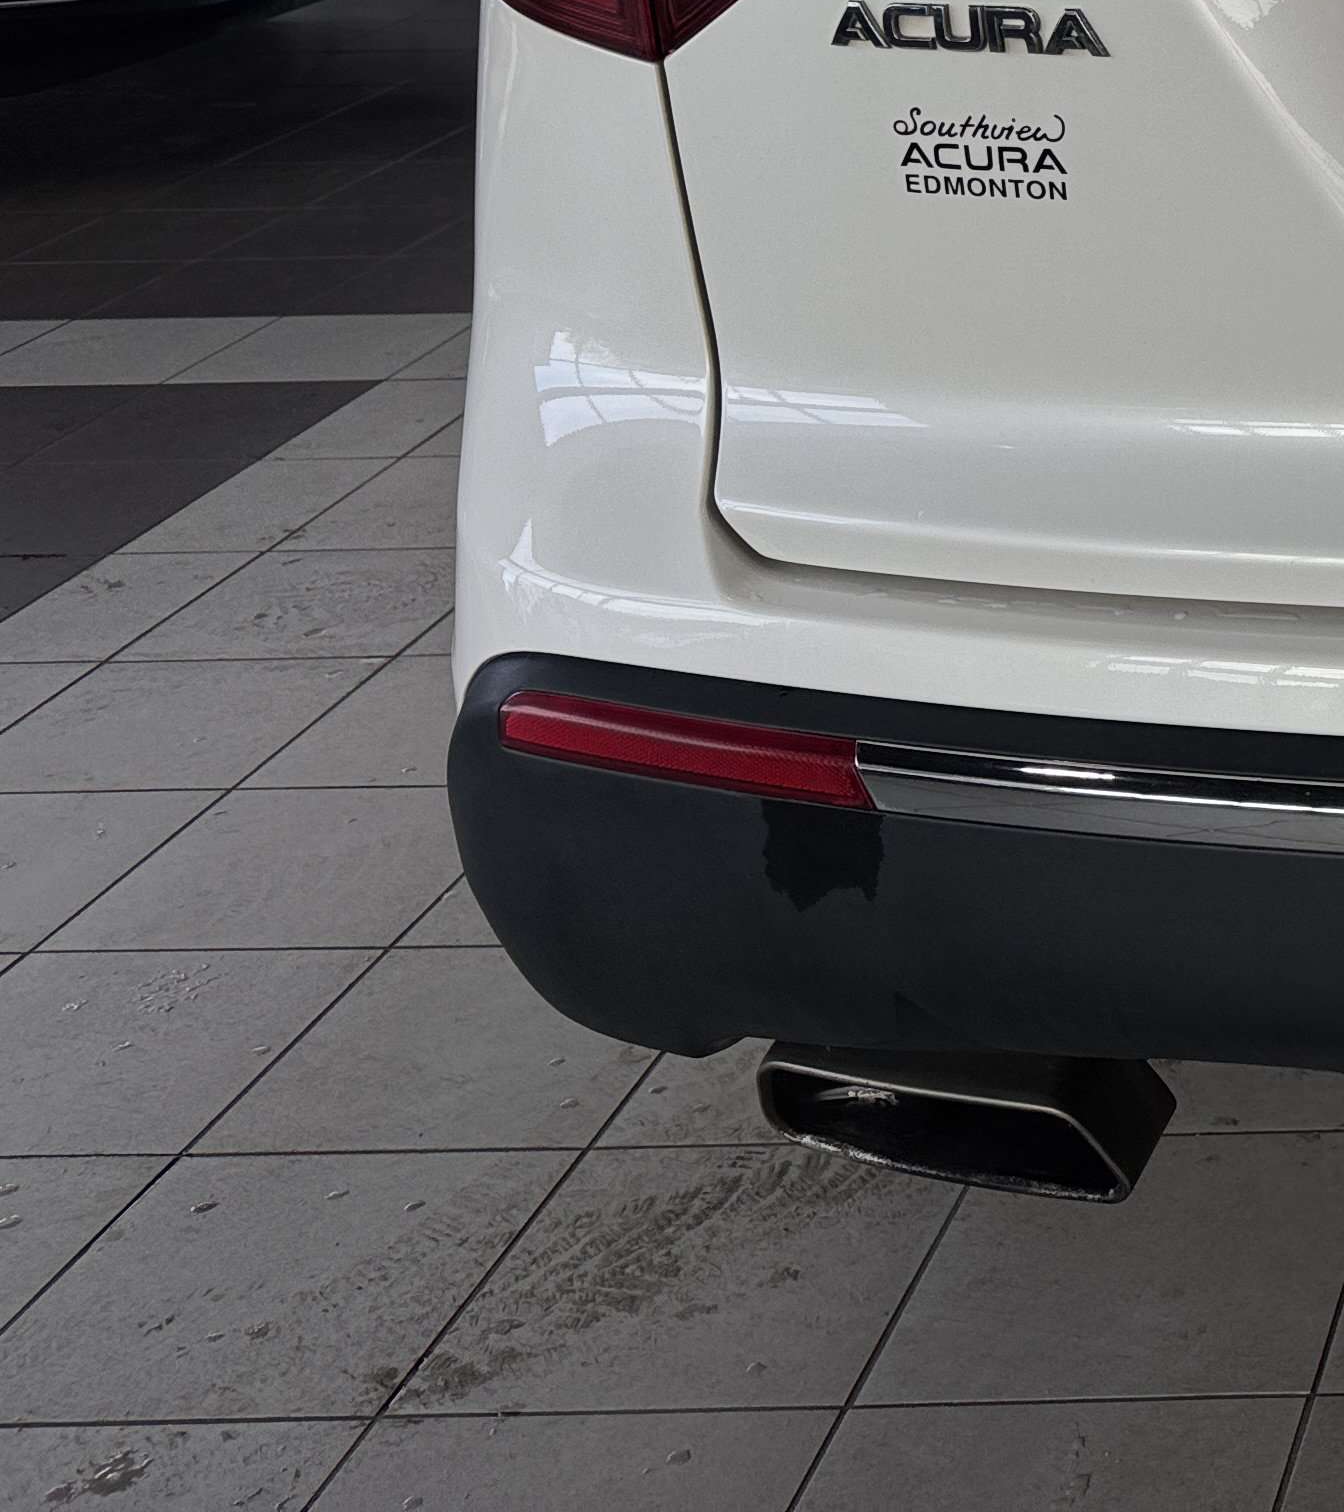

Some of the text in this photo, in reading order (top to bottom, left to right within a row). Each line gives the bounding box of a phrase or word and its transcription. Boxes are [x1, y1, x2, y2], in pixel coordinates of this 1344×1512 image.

[831, 0, 1111, 57] ACURA
[893, 107, 1066, 143] Southview
[900, 142, 1067, 174] ACURA
[905, 174, 1067, 200] EDMONTON
